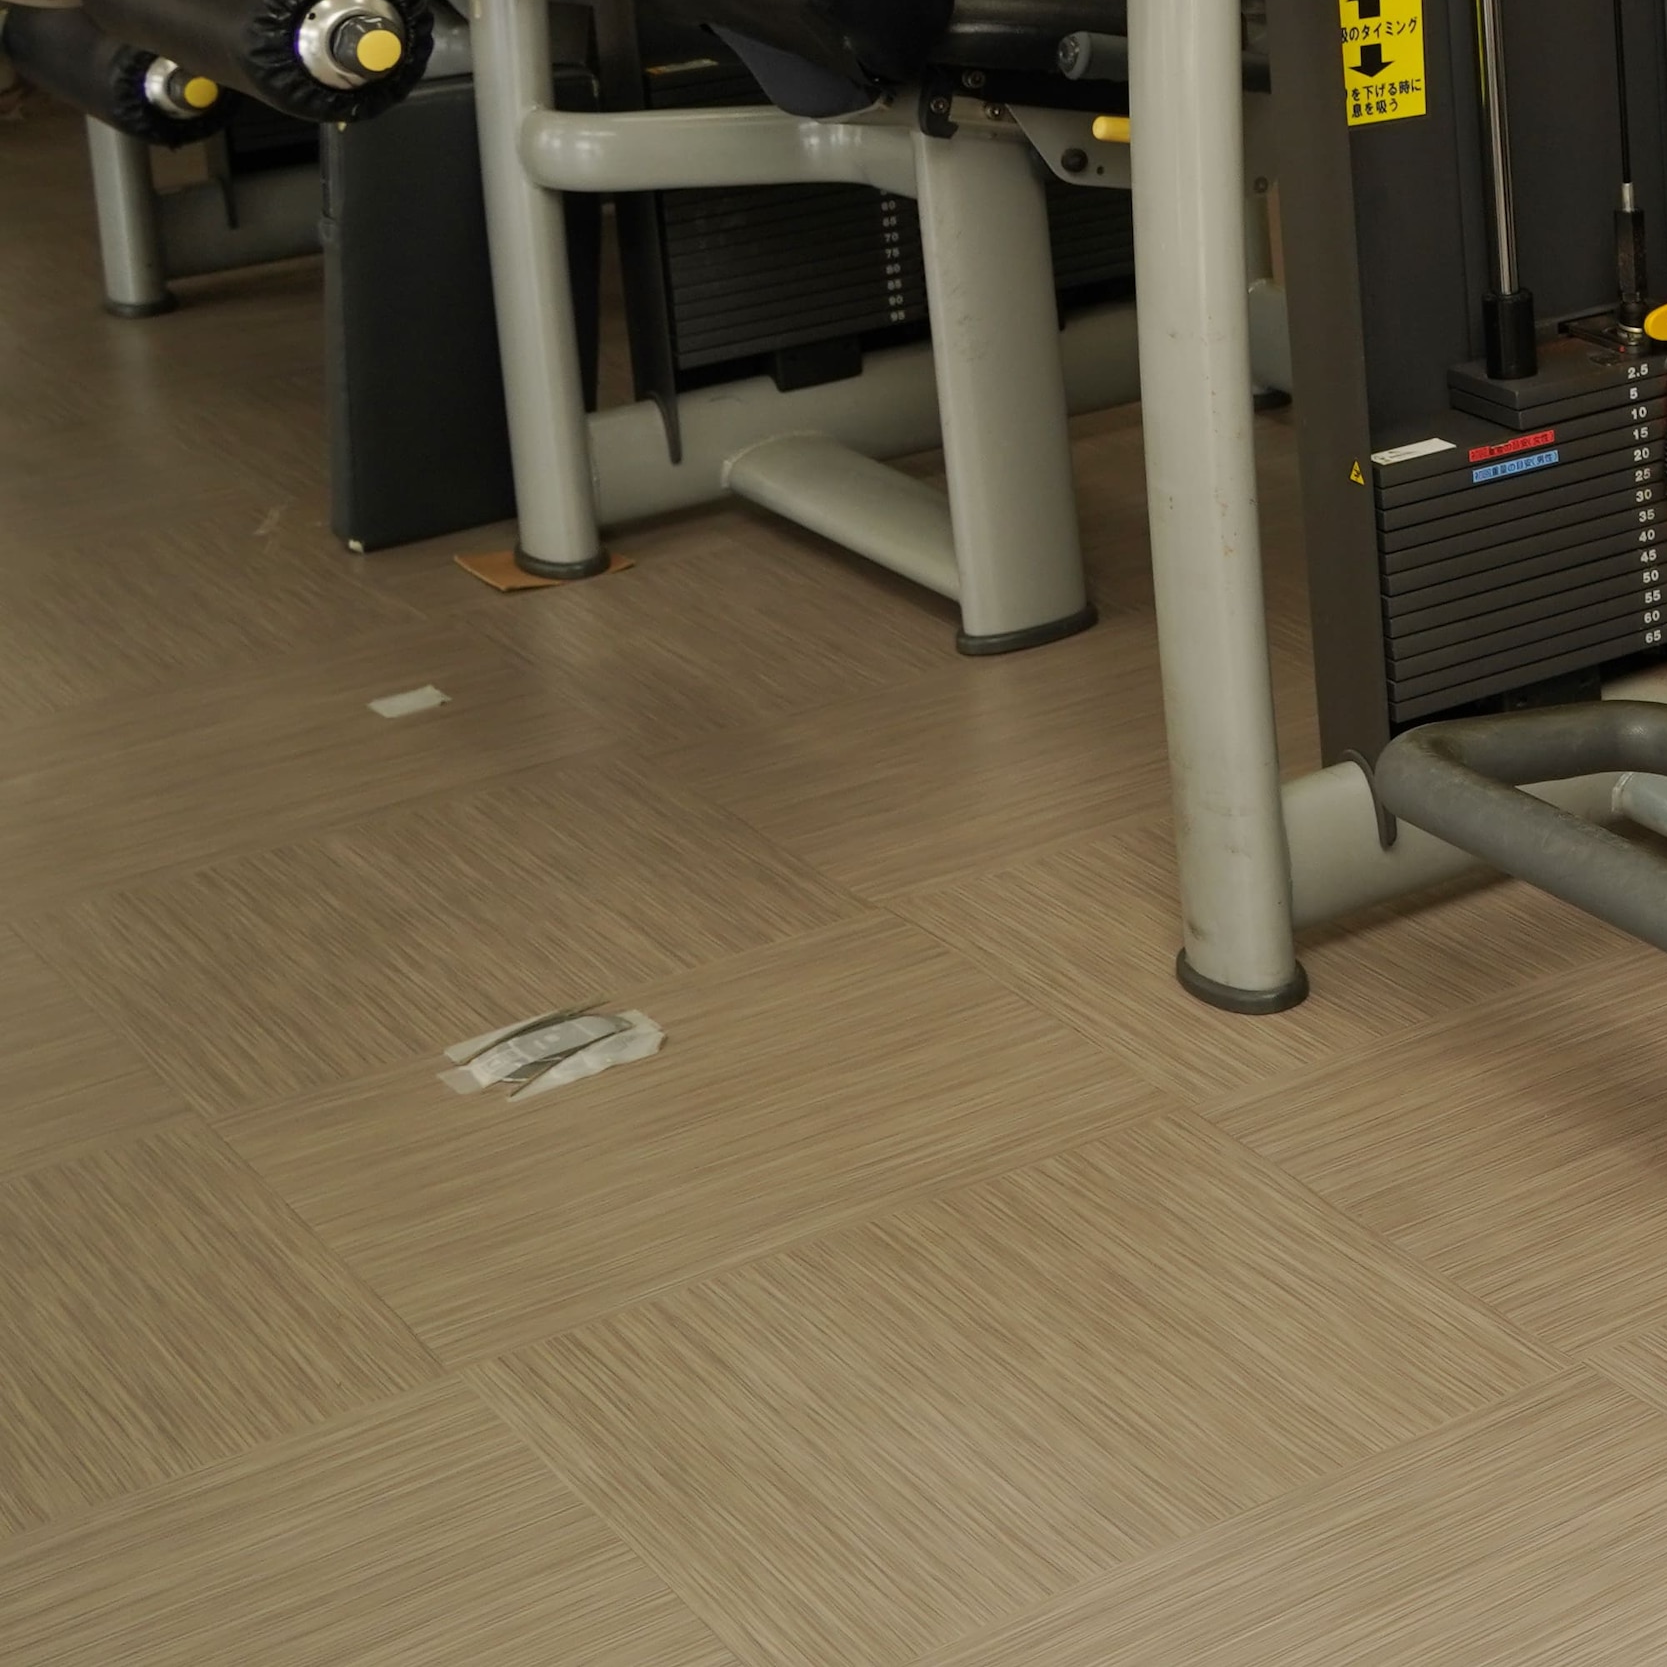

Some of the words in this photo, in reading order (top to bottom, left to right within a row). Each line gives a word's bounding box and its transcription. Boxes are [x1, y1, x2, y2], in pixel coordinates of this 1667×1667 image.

[1345, 78, 1421, 102] を下げる時に
[1352, 98, 1398, 118] 息を吸う
[1628, 364, 1649, 379] 2.5
[1629, 388, 1638, 400] 5
[1631, 407, 1647, 420] 10
[1633, 427, 1649, 440] 15
[1634, 448, 1650, 461] 20
[1635, 468, 1651, 483] 25
[1636, 488, 1652, 503] 30
[1638, 509, 1655, 523] 35
[1639, 529, 1656, 543] 40
[1640, 549, 1657, 564] 45
[1642, 569, 1659, 584] 50
[1645, 590, 1661, 604] 55
[1644, 610, 1661, 624] 60
[1645, 630, 1662, 644] 65
